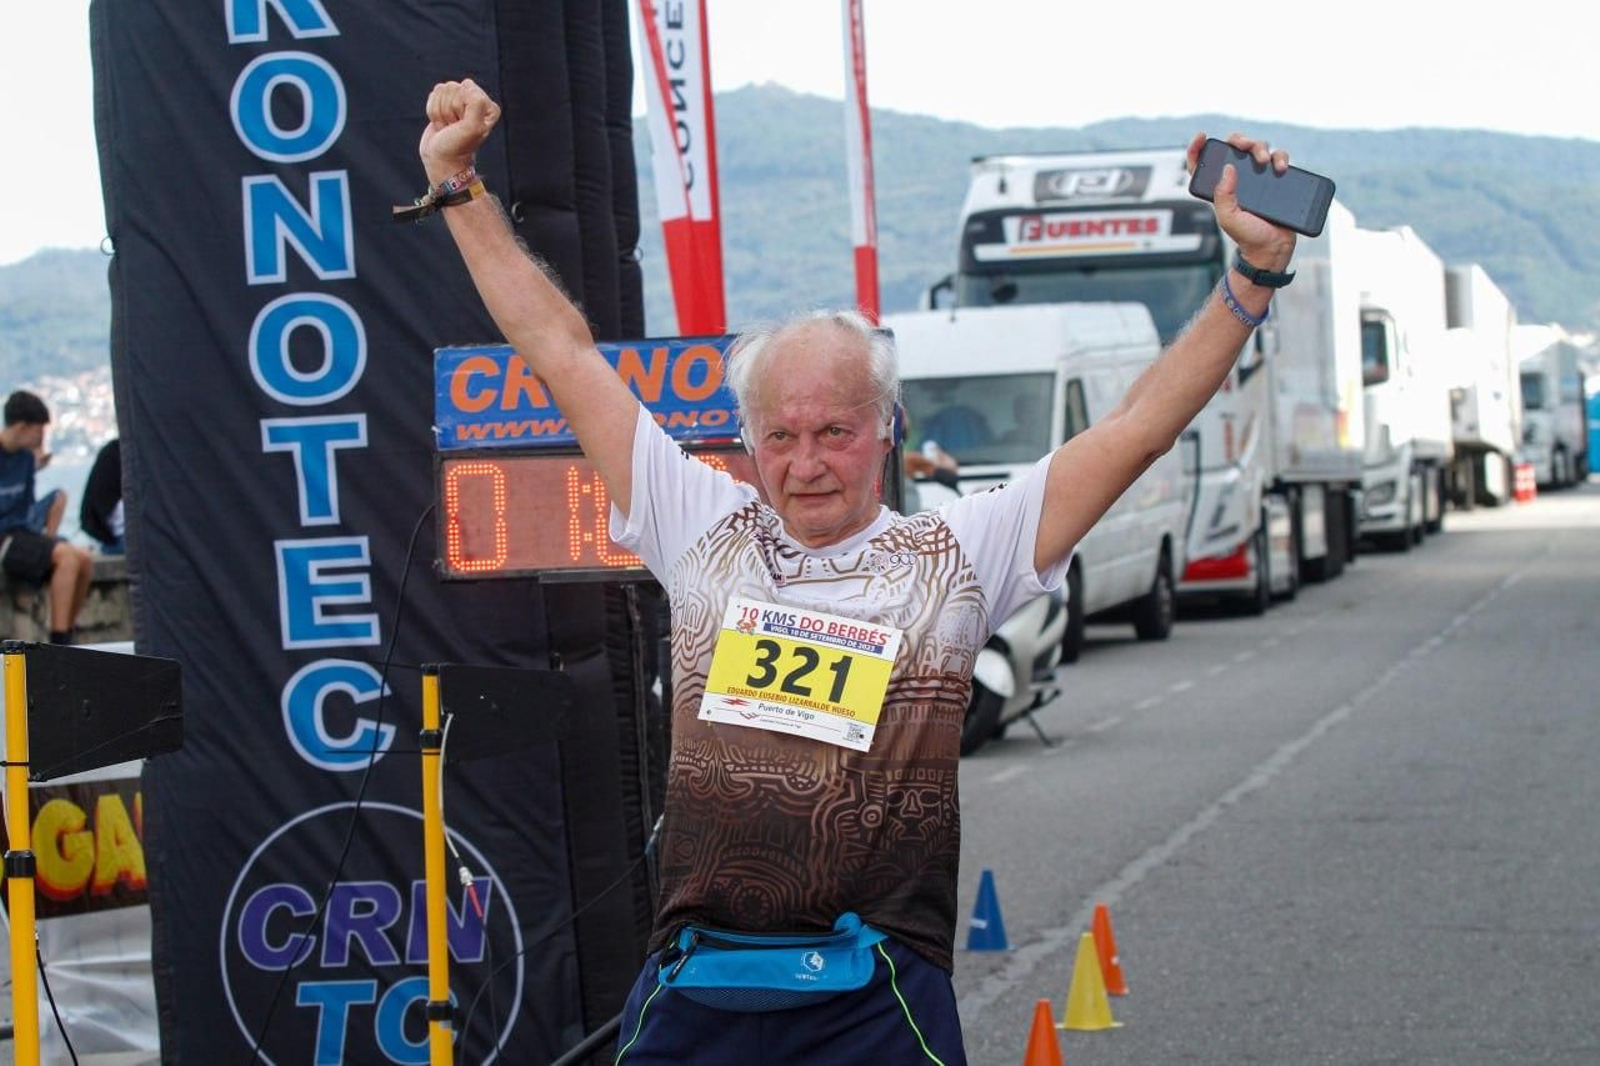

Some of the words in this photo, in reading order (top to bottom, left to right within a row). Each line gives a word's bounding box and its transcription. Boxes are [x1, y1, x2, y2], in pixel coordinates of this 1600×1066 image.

[450, 344, 725, 413] CRNO
[742, 607, 759, 621] 10
[761, 609, 797, 627] KMS
[800, 617, 824, 632] DO
[827, 621, 889, 646] BERBÉS
[810, 632, 846, 646] SETEMBRO
[846, 640, 857, 648] DE
[746, 639, 853, 704] 321
[727, 686, 758, 698] EDUARDO
[758, 691, 787, 703] EUSEBIO
[788, 695, 831, 712] LIZARRALDE
[832, 705, 856, 718] HUESO
[758, 703, 783, 715] Puerto
[785, 707, 796, 716] de
[797, 709, 815, 720] Vigo
